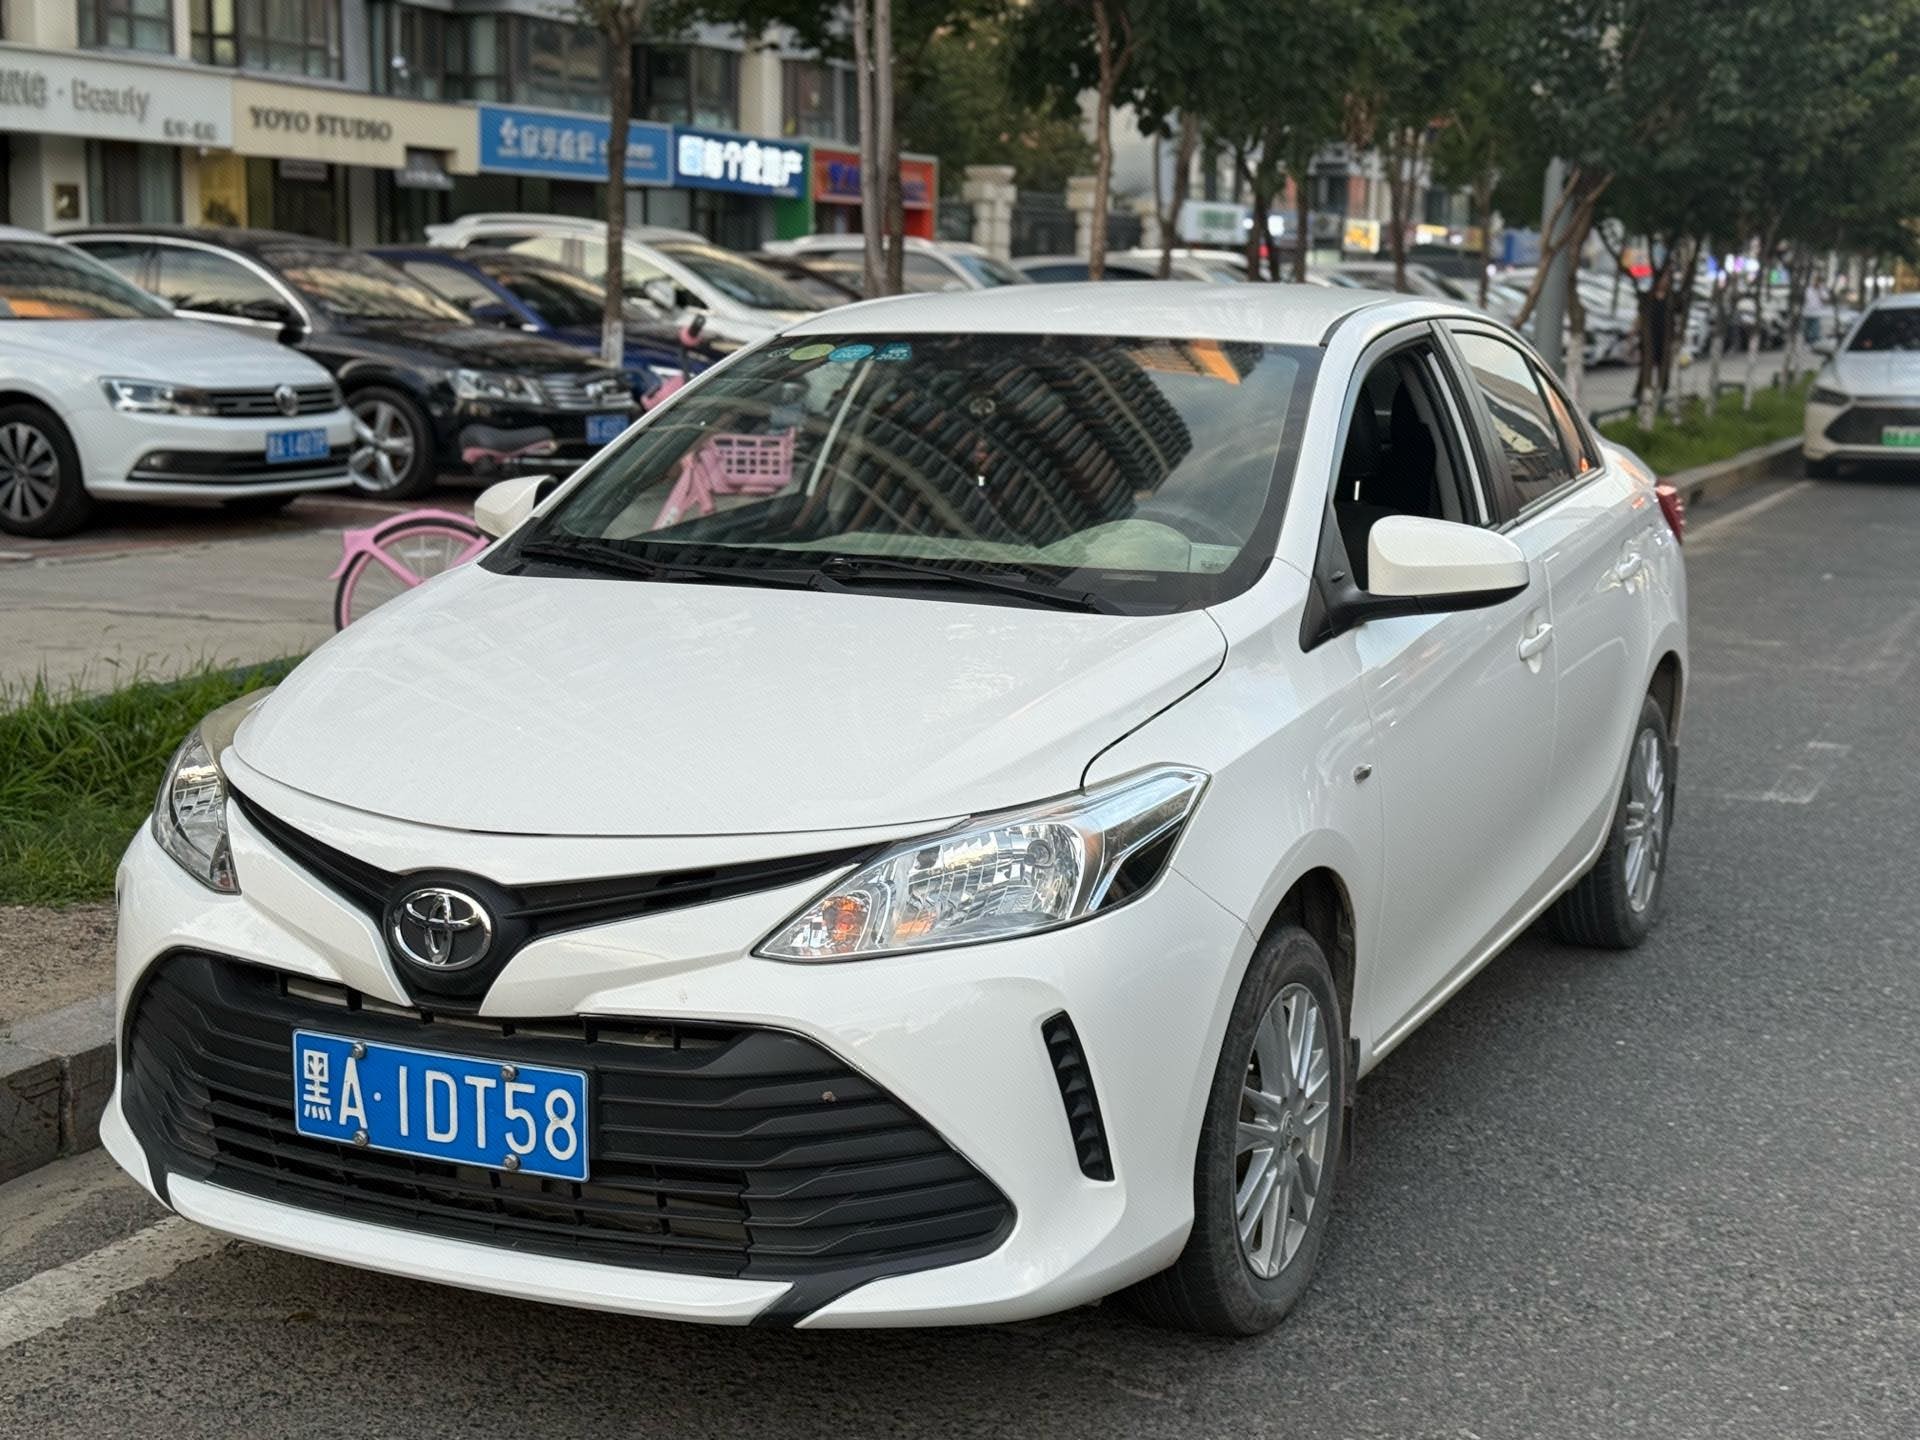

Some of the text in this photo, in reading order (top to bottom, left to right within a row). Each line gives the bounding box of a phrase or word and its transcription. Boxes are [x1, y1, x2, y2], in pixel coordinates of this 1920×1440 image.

[71, 77, 150, 122] Beauty
[249, 106, 311, 133] YOYO
[316, 113, 393, 142] STUDIO
[303, 1049, 578, 1161] 黑A·1DT58
